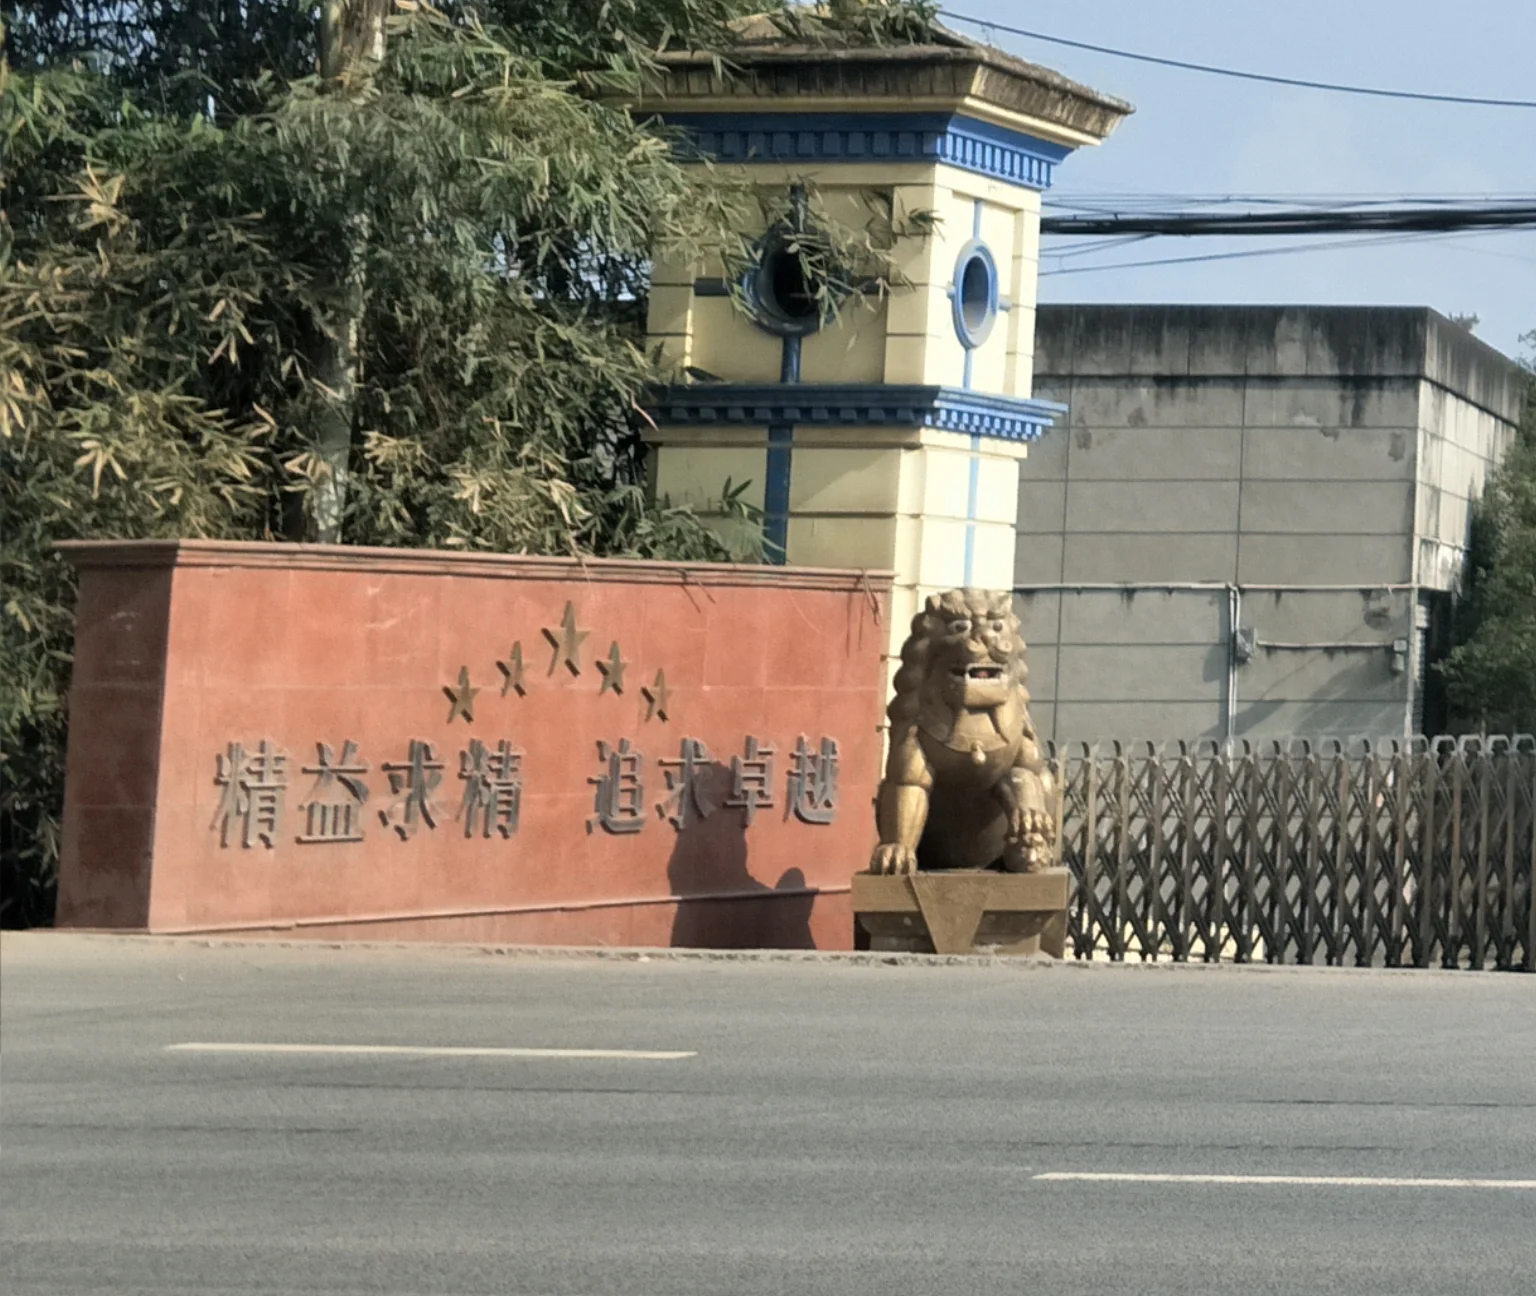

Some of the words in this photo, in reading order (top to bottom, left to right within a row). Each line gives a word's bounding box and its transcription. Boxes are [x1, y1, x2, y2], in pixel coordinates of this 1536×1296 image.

[209, 738, 525, 848] 精益求精
[585, 732, 839, 836] 追求卓越
